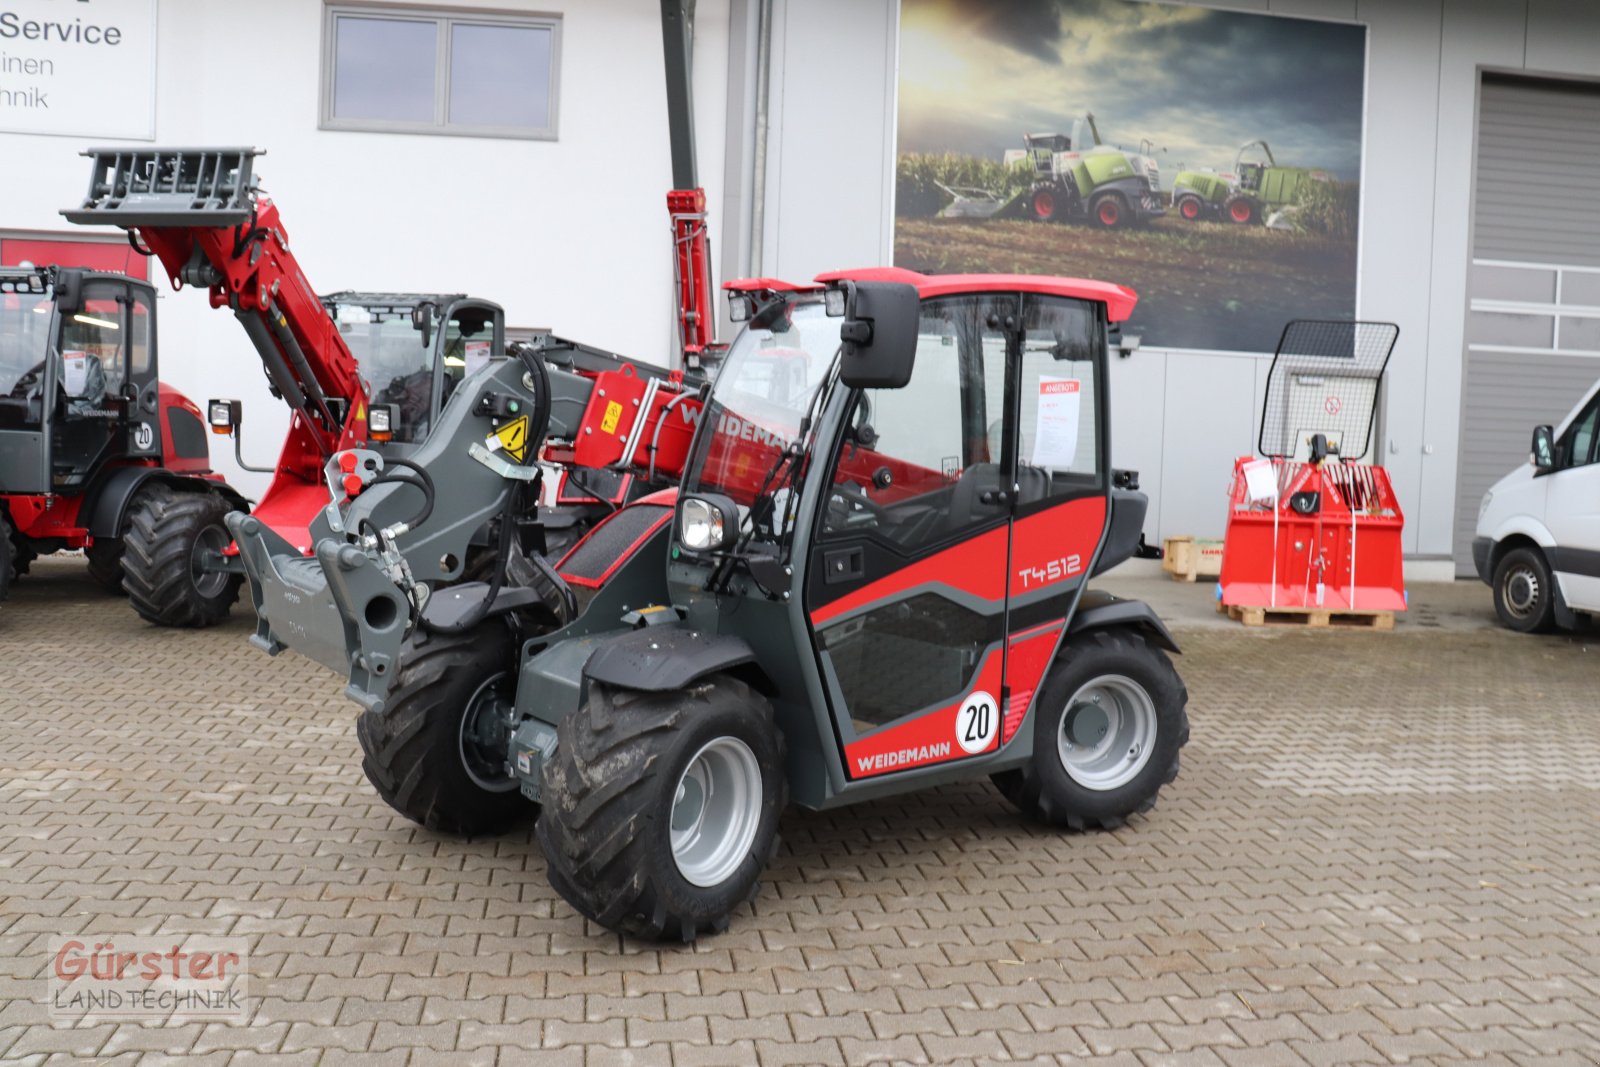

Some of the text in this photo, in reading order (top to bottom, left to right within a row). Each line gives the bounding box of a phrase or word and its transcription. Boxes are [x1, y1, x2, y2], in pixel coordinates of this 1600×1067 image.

[0, 12, 122, 46] Service
[82, 409, 120, 417] WEIDEMANN
[139, 427, 150, 444] 20
[1018, 553, 1081, 588] T4512
[964, 703, 990, 742] 20
[857, 741, 951, 772] WEIDEMANN
